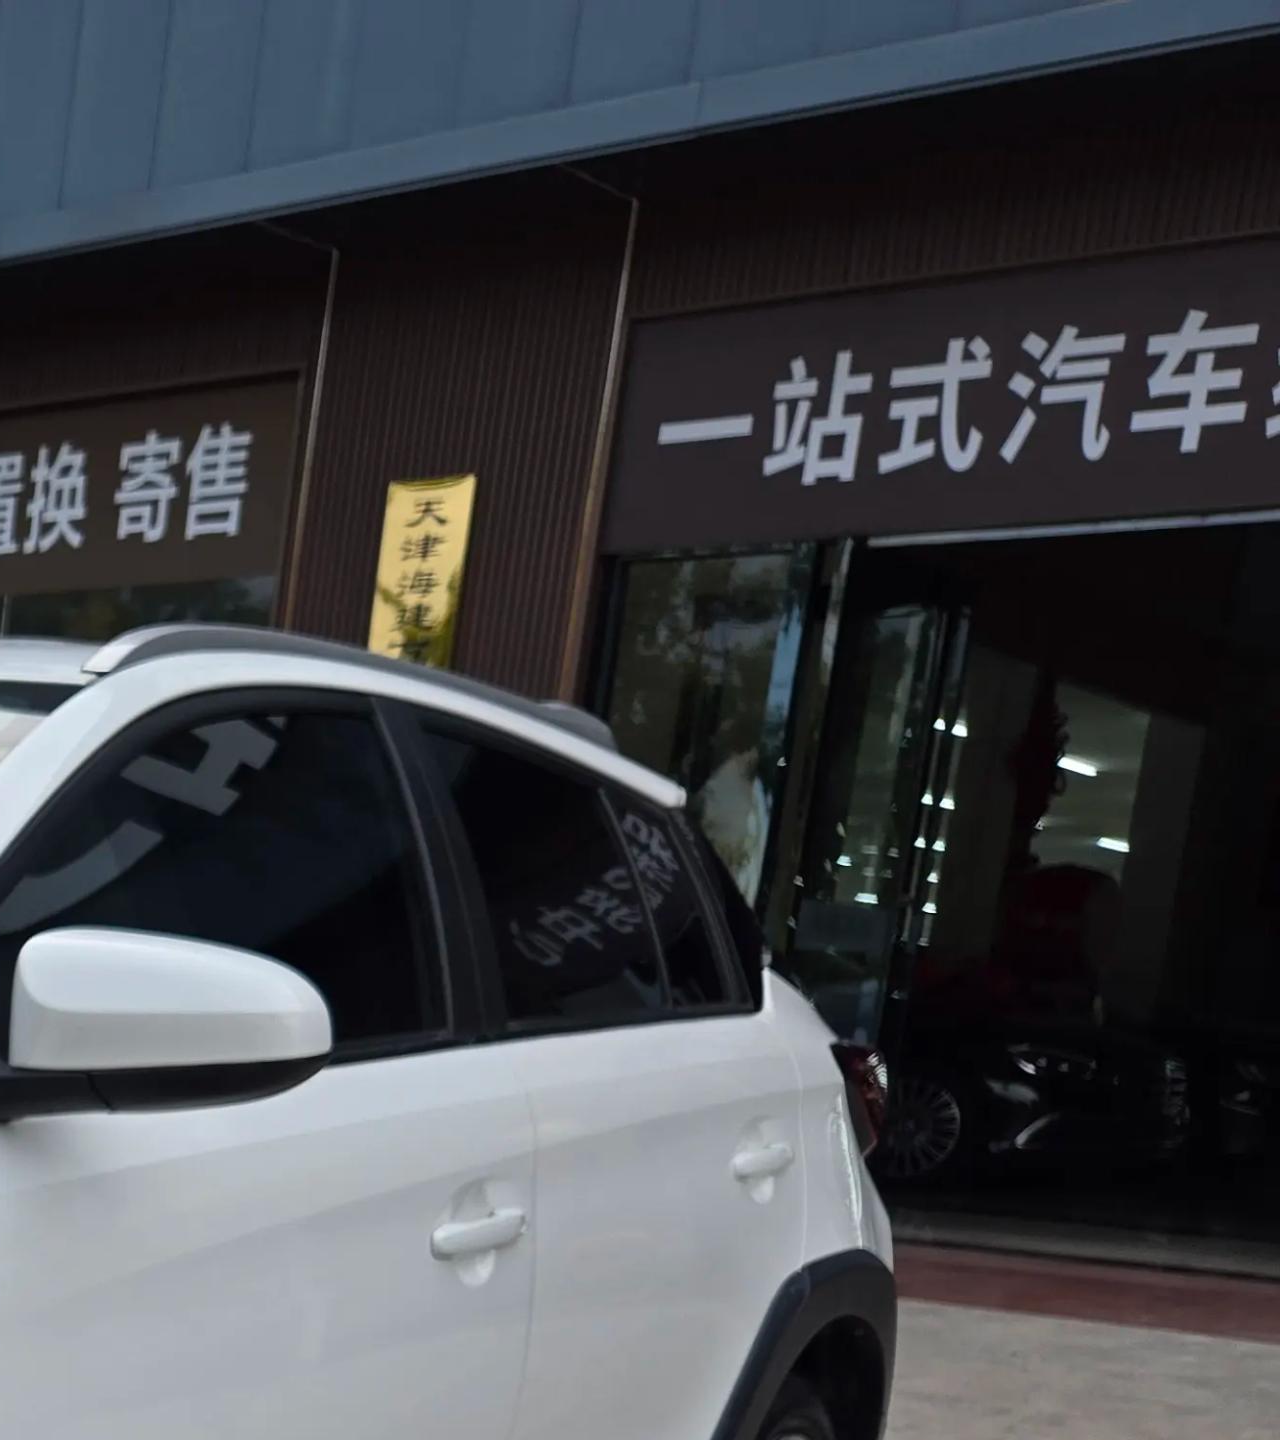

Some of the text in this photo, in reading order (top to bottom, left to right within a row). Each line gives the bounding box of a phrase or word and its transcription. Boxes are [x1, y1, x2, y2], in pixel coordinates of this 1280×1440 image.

[656, 308, 1280, 487] 一站式汽车
[113, 421, 254, 544] 寄售
